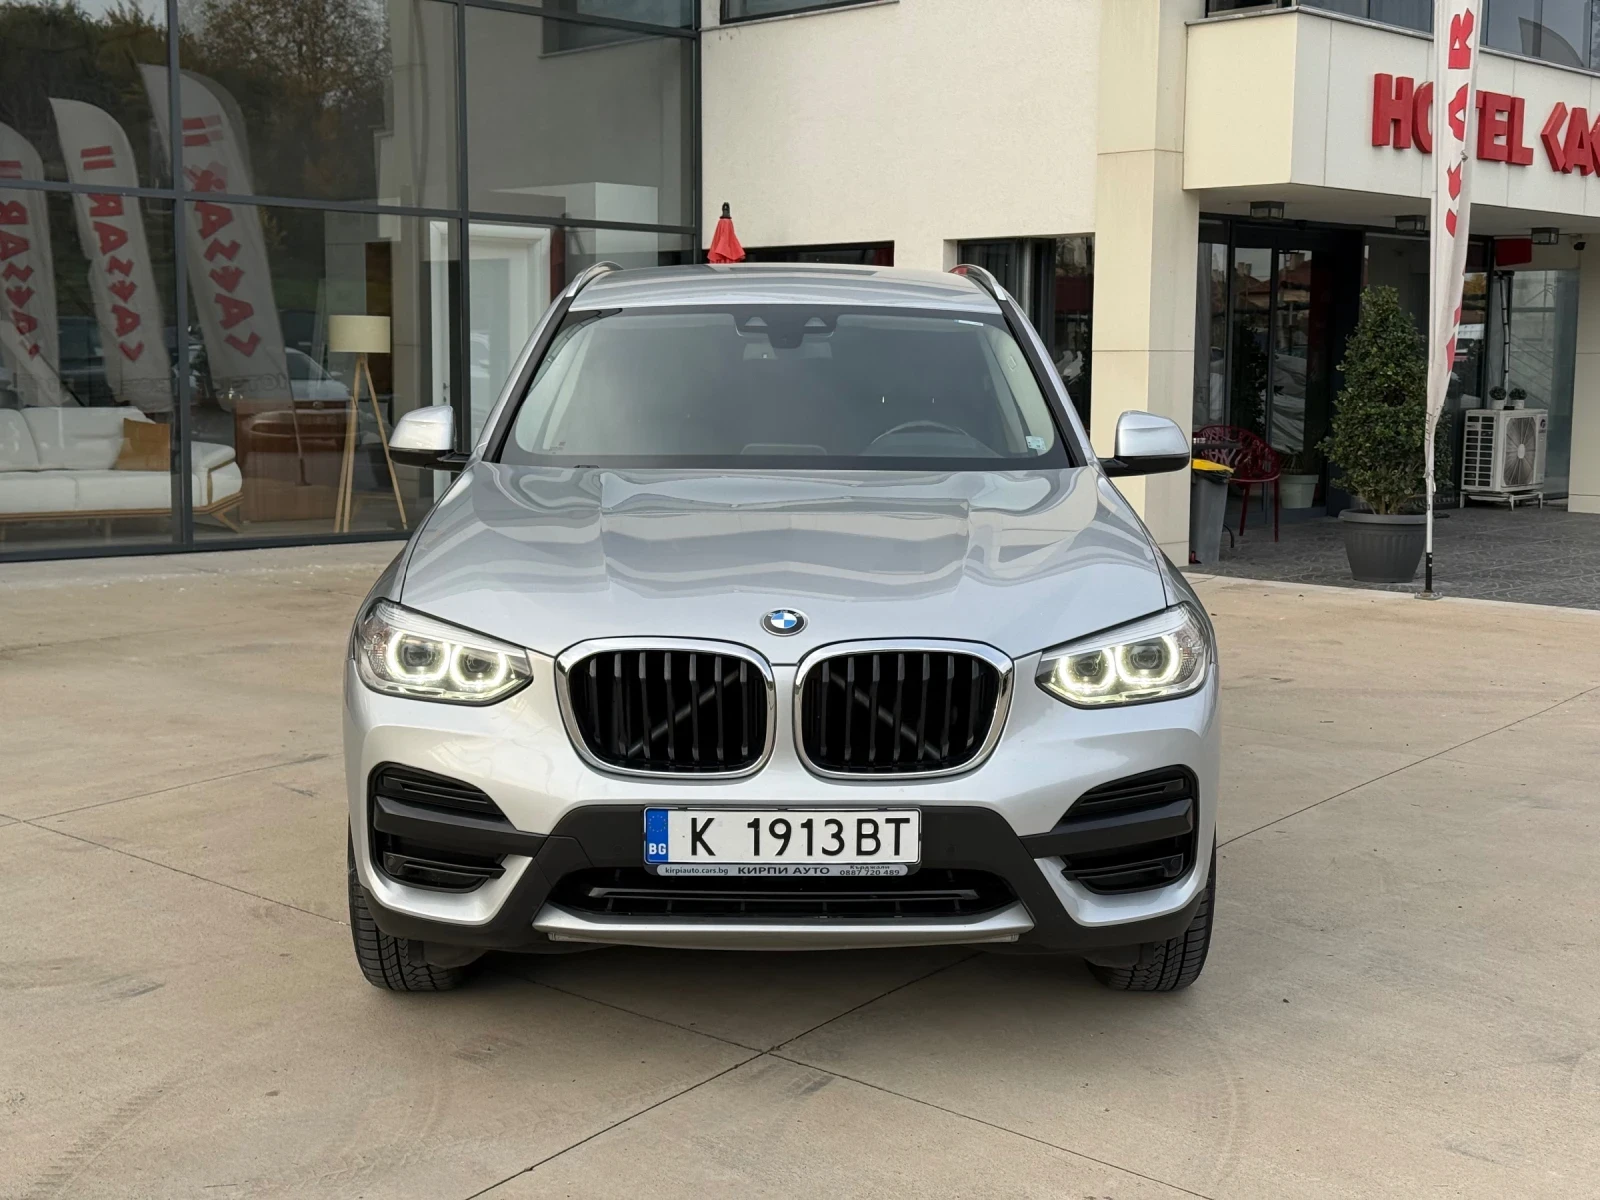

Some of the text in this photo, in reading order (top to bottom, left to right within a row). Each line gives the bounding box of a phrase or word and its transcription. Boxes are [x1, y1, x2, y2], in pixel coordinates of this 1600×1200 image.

[649, 843, 667, 855] BG
[664, 865, 729, 875] kirpiauto.cars.bg
[737, 866, 830, 875] КИРПИ АУТО
